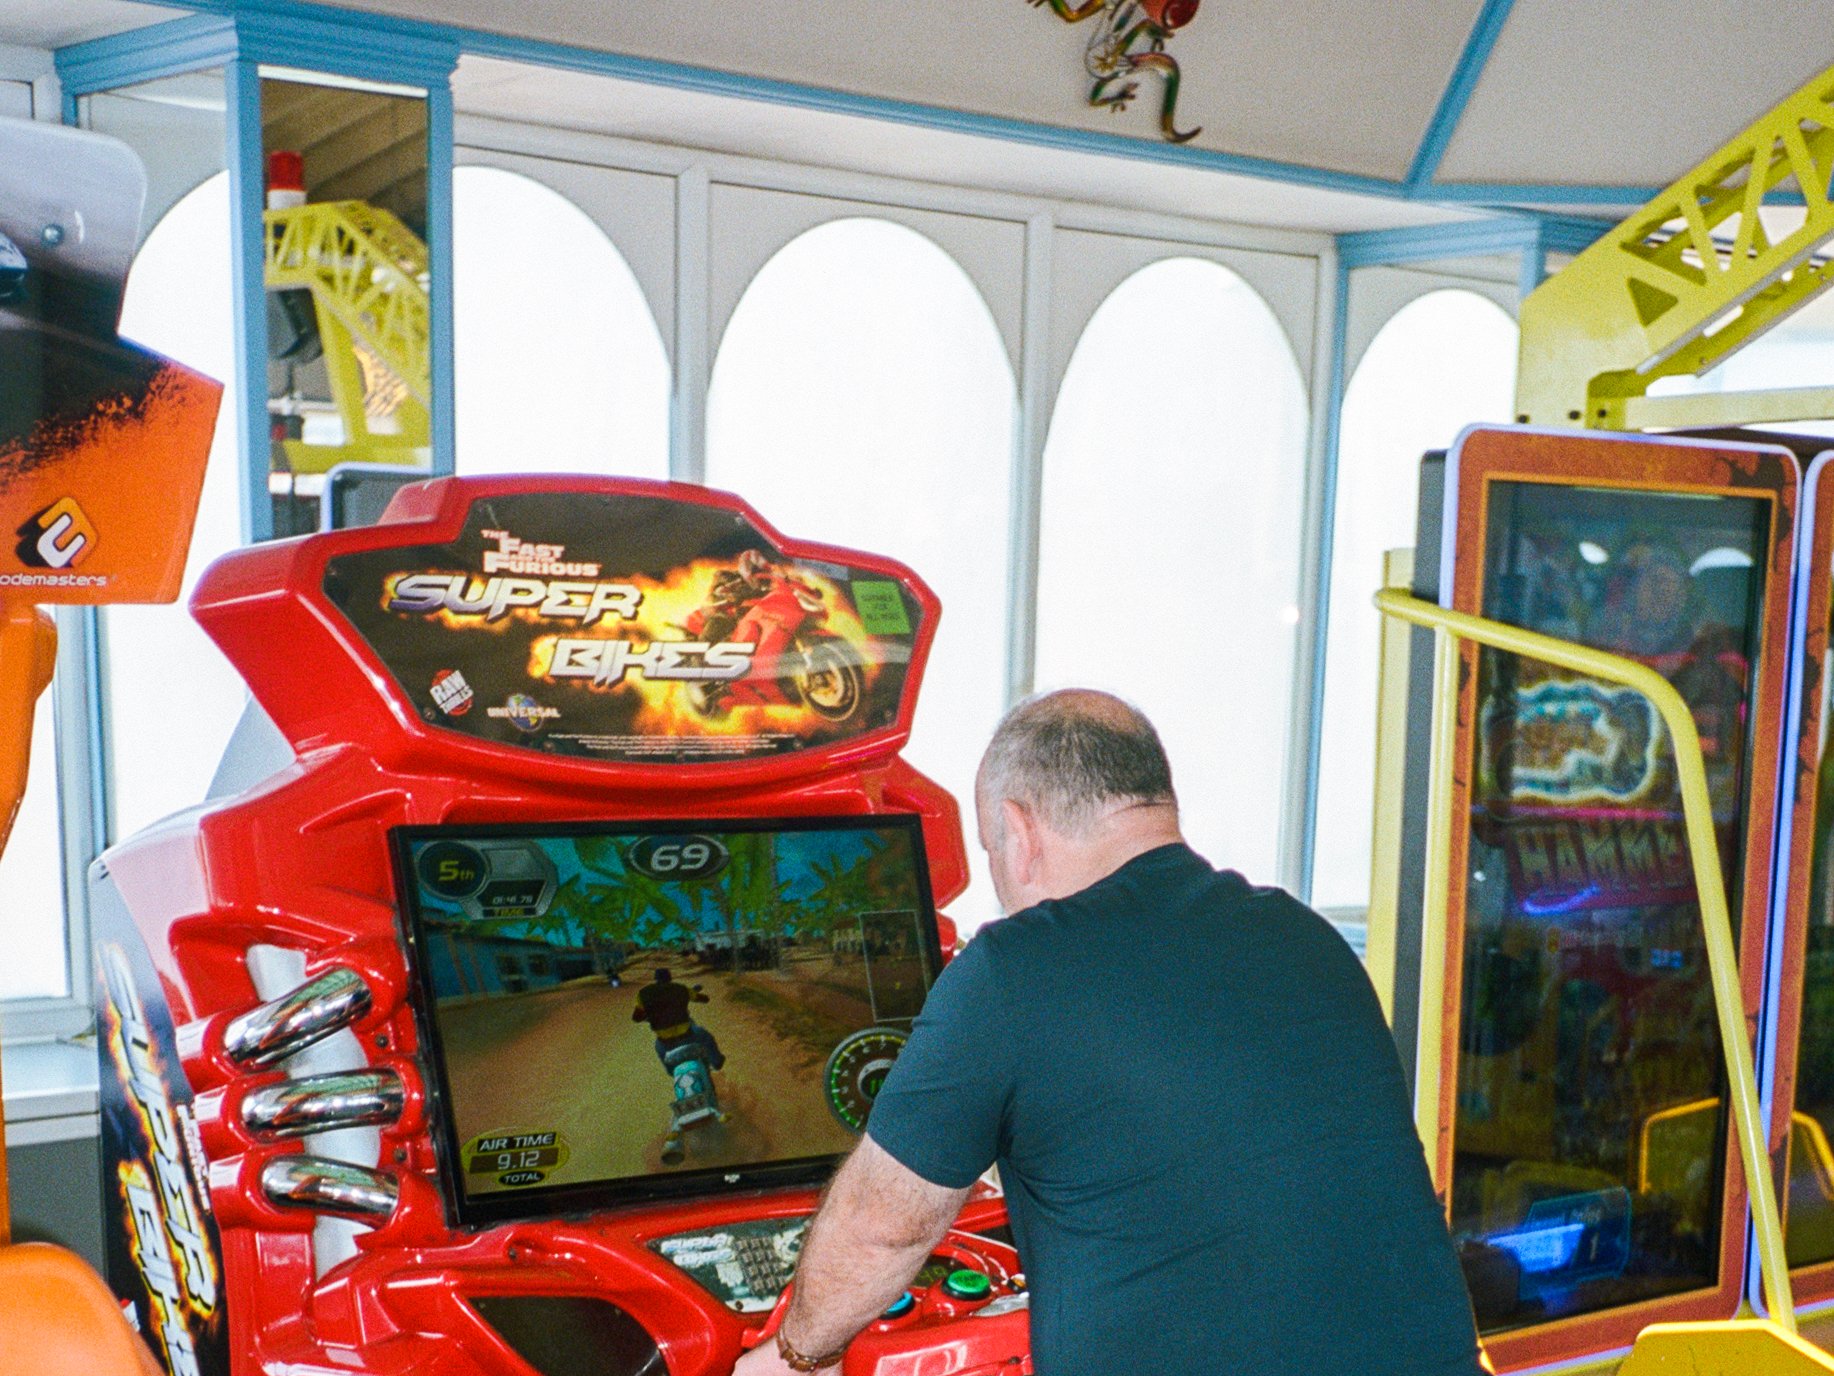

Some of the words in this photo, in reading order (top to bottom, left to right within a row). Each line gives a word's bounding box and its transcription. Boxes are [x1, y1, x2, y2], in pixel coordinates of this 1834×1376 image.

[499, 538, 565, 558] FAST
[483, 551, 601, 577] FURIOUS
[0, 574, 107, 586] odemasters
[389, 574, 643, 625] SUPER
[548, 636, 756, 687] BIKES
[429, 669, 466, 704] RAW
[487, 704, 562, 718] UNIVERSAL
[651, 844, 710, 871] 69
[439, 860, 475, 881] 5th
[100, 944, 217, 1314] SUPER
[479, 1138, 508, 1151] AIR
[513, 1133, 554, 1147] TIME
[497, 1150, 540, 1170] 9.12
[503, 1173, 540, 1183] TOTAL
